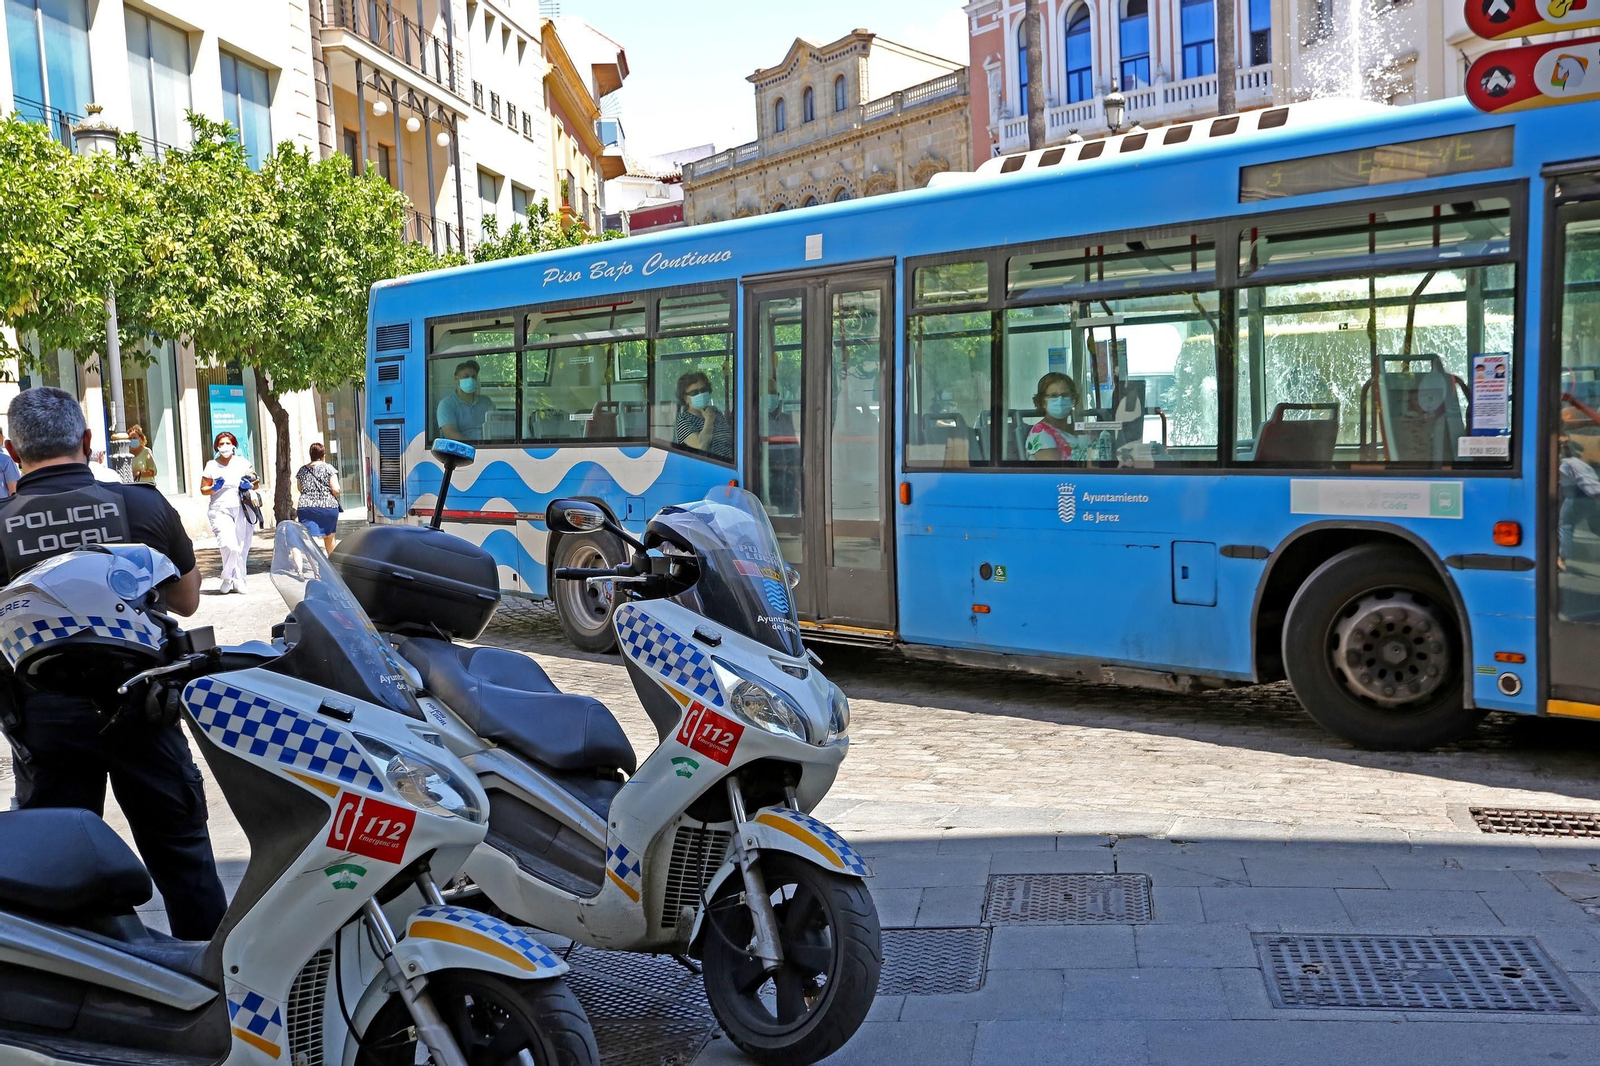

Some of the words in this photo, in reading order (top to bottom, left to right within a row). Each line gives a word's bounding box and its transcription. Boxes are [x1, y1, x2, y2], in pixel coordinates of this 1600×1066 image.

[542, 267, 582, 288] Piso
[589, 260, 634, 282] Bajo
[641, 250, 732, 276] Continuo
[1082, 492, 1149, 504] Ayuntamiento
[5, 502, 120, 534] POLICIA
[1082, 511, 1094, 521] de
[1095, 511, 1120, 524] Jerez
[17, 526, 123, 556] LOCAL
[0, 599, 31, 617] EREZ
[772, 623, 782, 631] de
[702, 723, 735, 747] 112
[364, 816, 407, 841] 112
[358, 833, 400, 849] Emergencas
